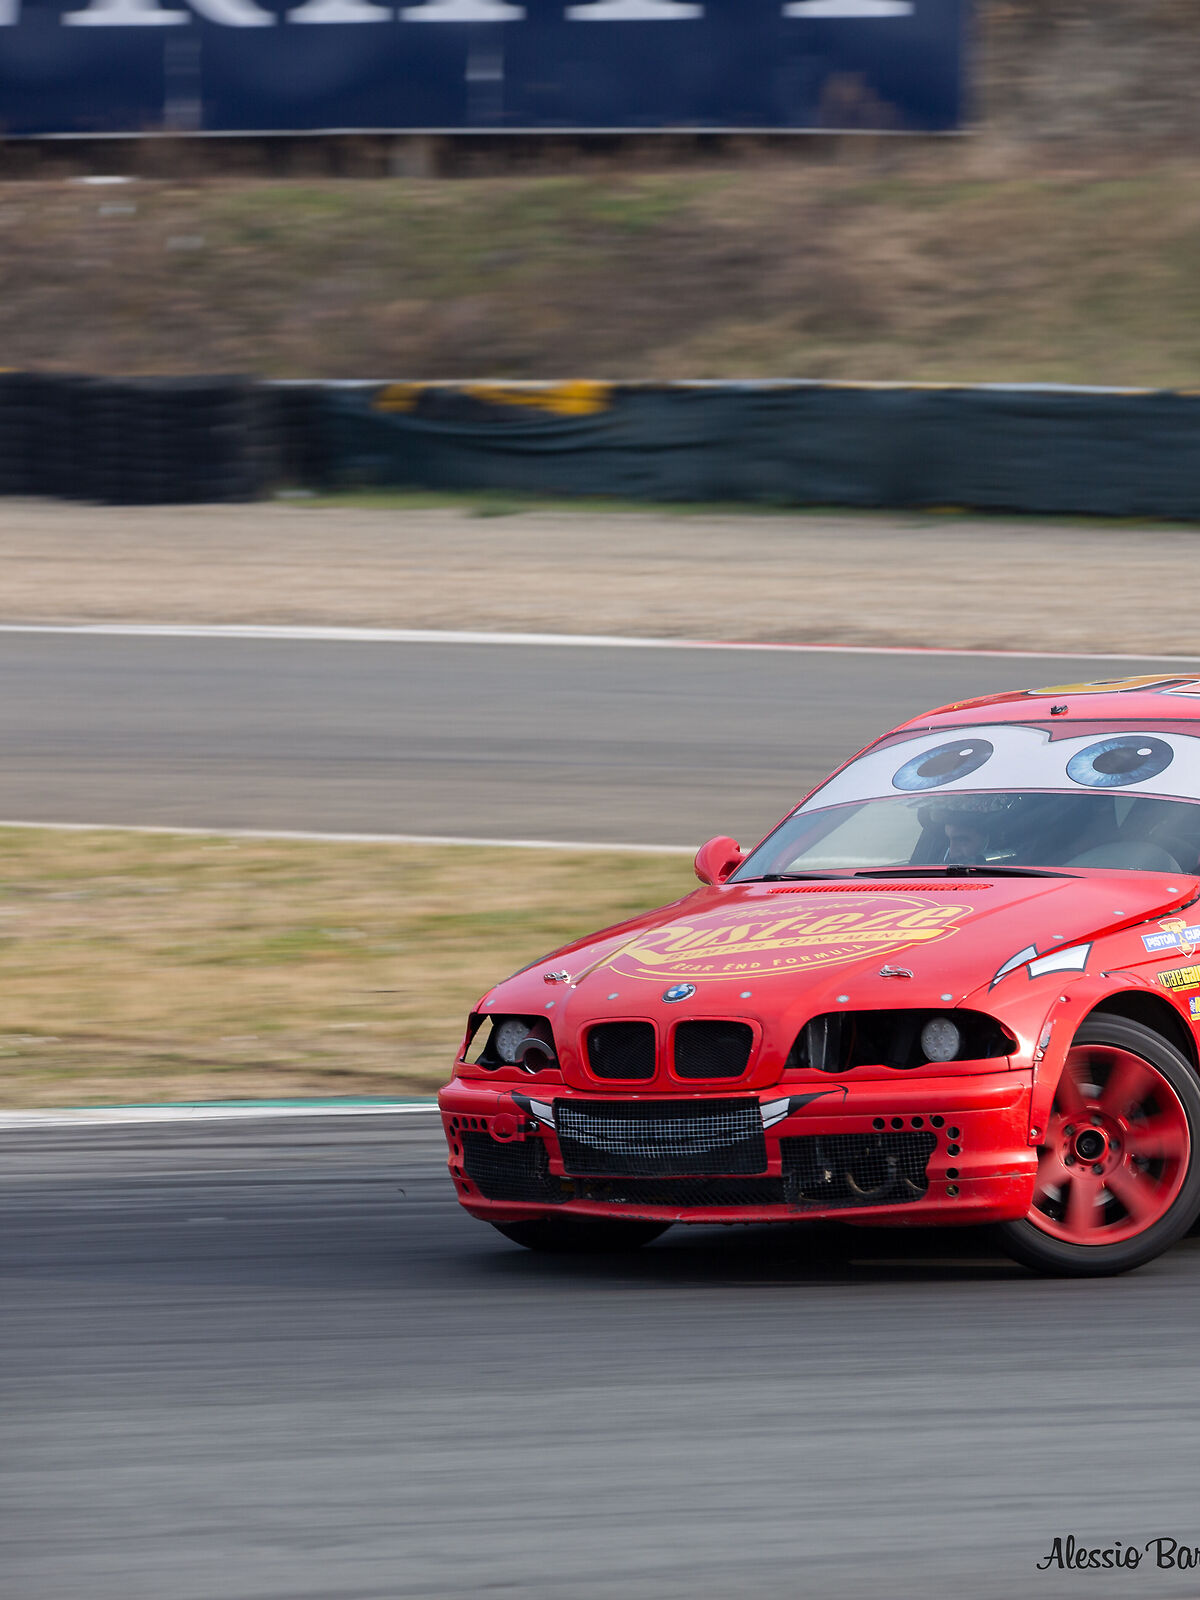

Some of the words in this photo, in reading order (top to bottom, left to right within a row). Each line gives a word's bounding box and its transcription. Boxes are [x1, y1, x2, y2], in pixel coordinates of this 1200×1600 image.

[1145, 933, 1177, 948] PISTON
[722, 961, 761, 971] END
[773, 944, 867, 966] FORMULA
